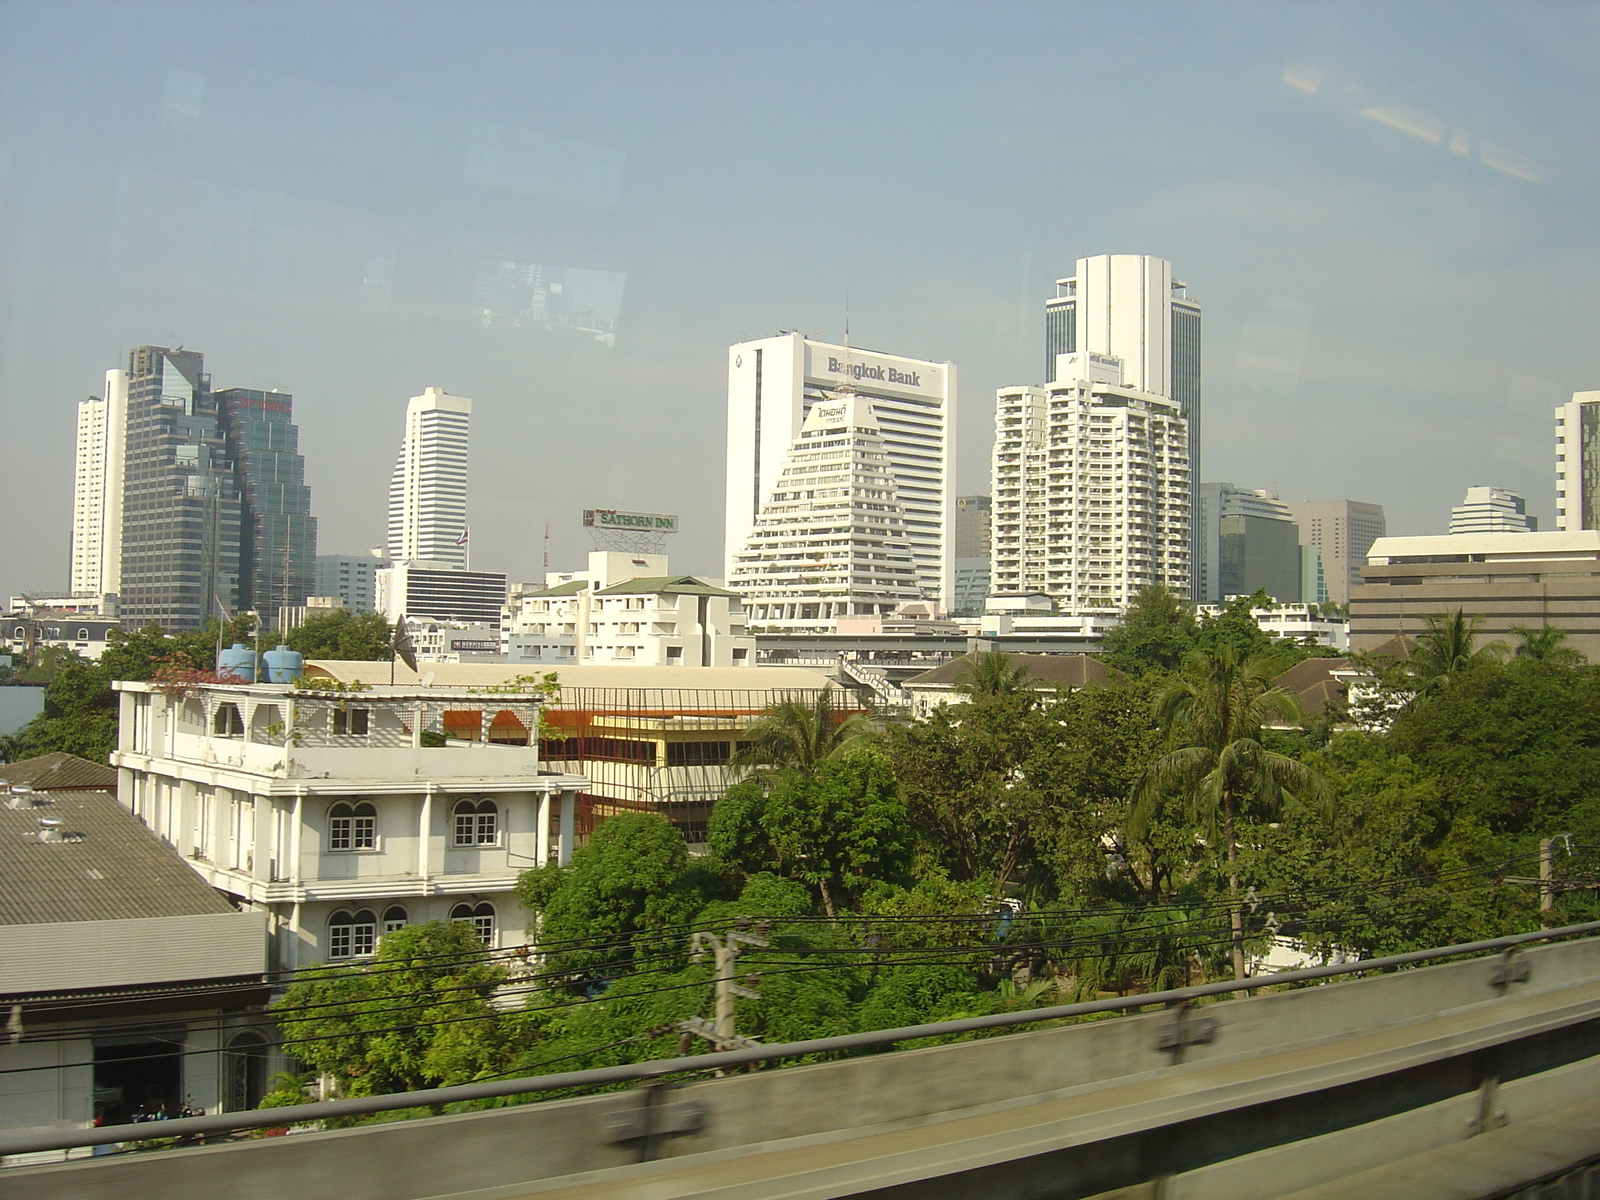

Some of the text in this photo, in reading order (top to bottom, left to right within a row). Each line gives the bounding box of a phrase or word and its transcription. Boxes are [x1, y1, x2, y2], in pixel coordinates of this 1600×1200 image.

[828, 356, 920, 387] Bangkok Bank
[601, 513, 674, 528] SATHORN INN
